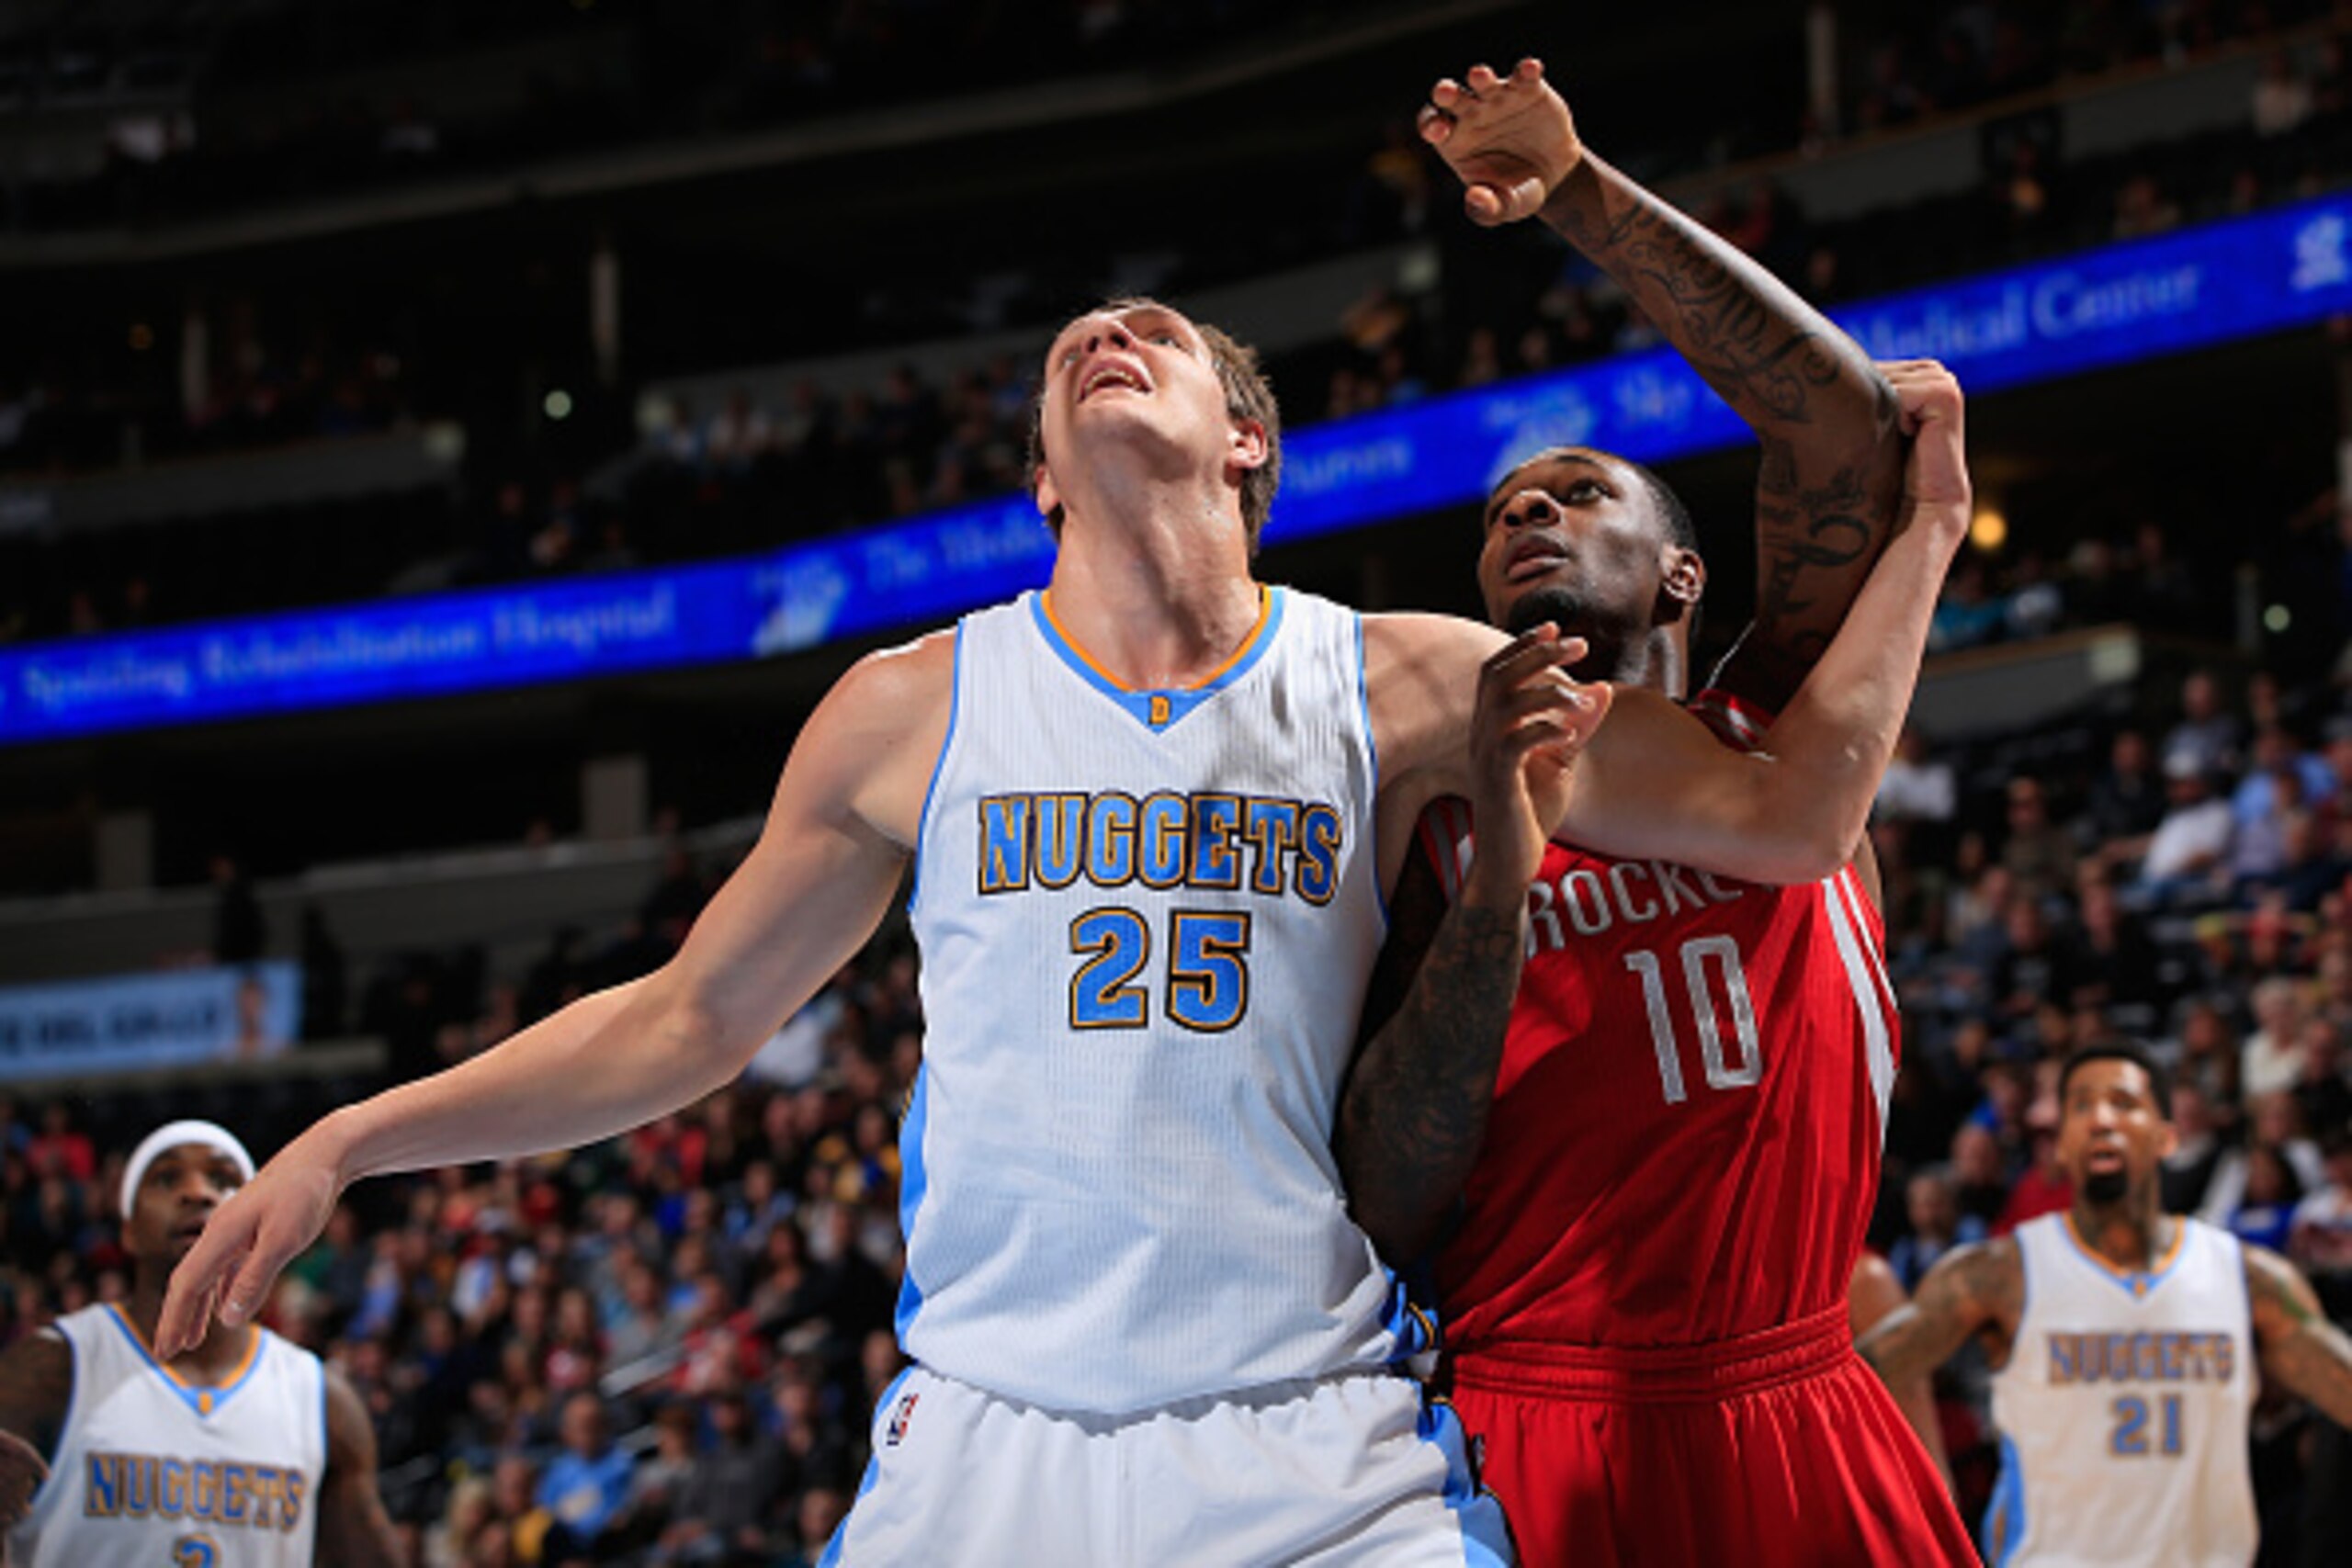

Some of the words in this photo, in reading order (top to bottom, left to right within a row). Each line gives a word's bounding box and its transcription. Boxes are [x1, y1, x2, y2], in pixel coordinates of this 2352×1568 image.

[978, 791, 1342, 906] NUGGETS
[1069, 906, 1251, 1032] 25
[1623, 934, 1763, 1104] 10
[2047, 1329, 2235, 1386] NUGGETS
[2107, 1392, 2186, 1459] 21
[85, 1451, 307, 1533] NUGGETS
